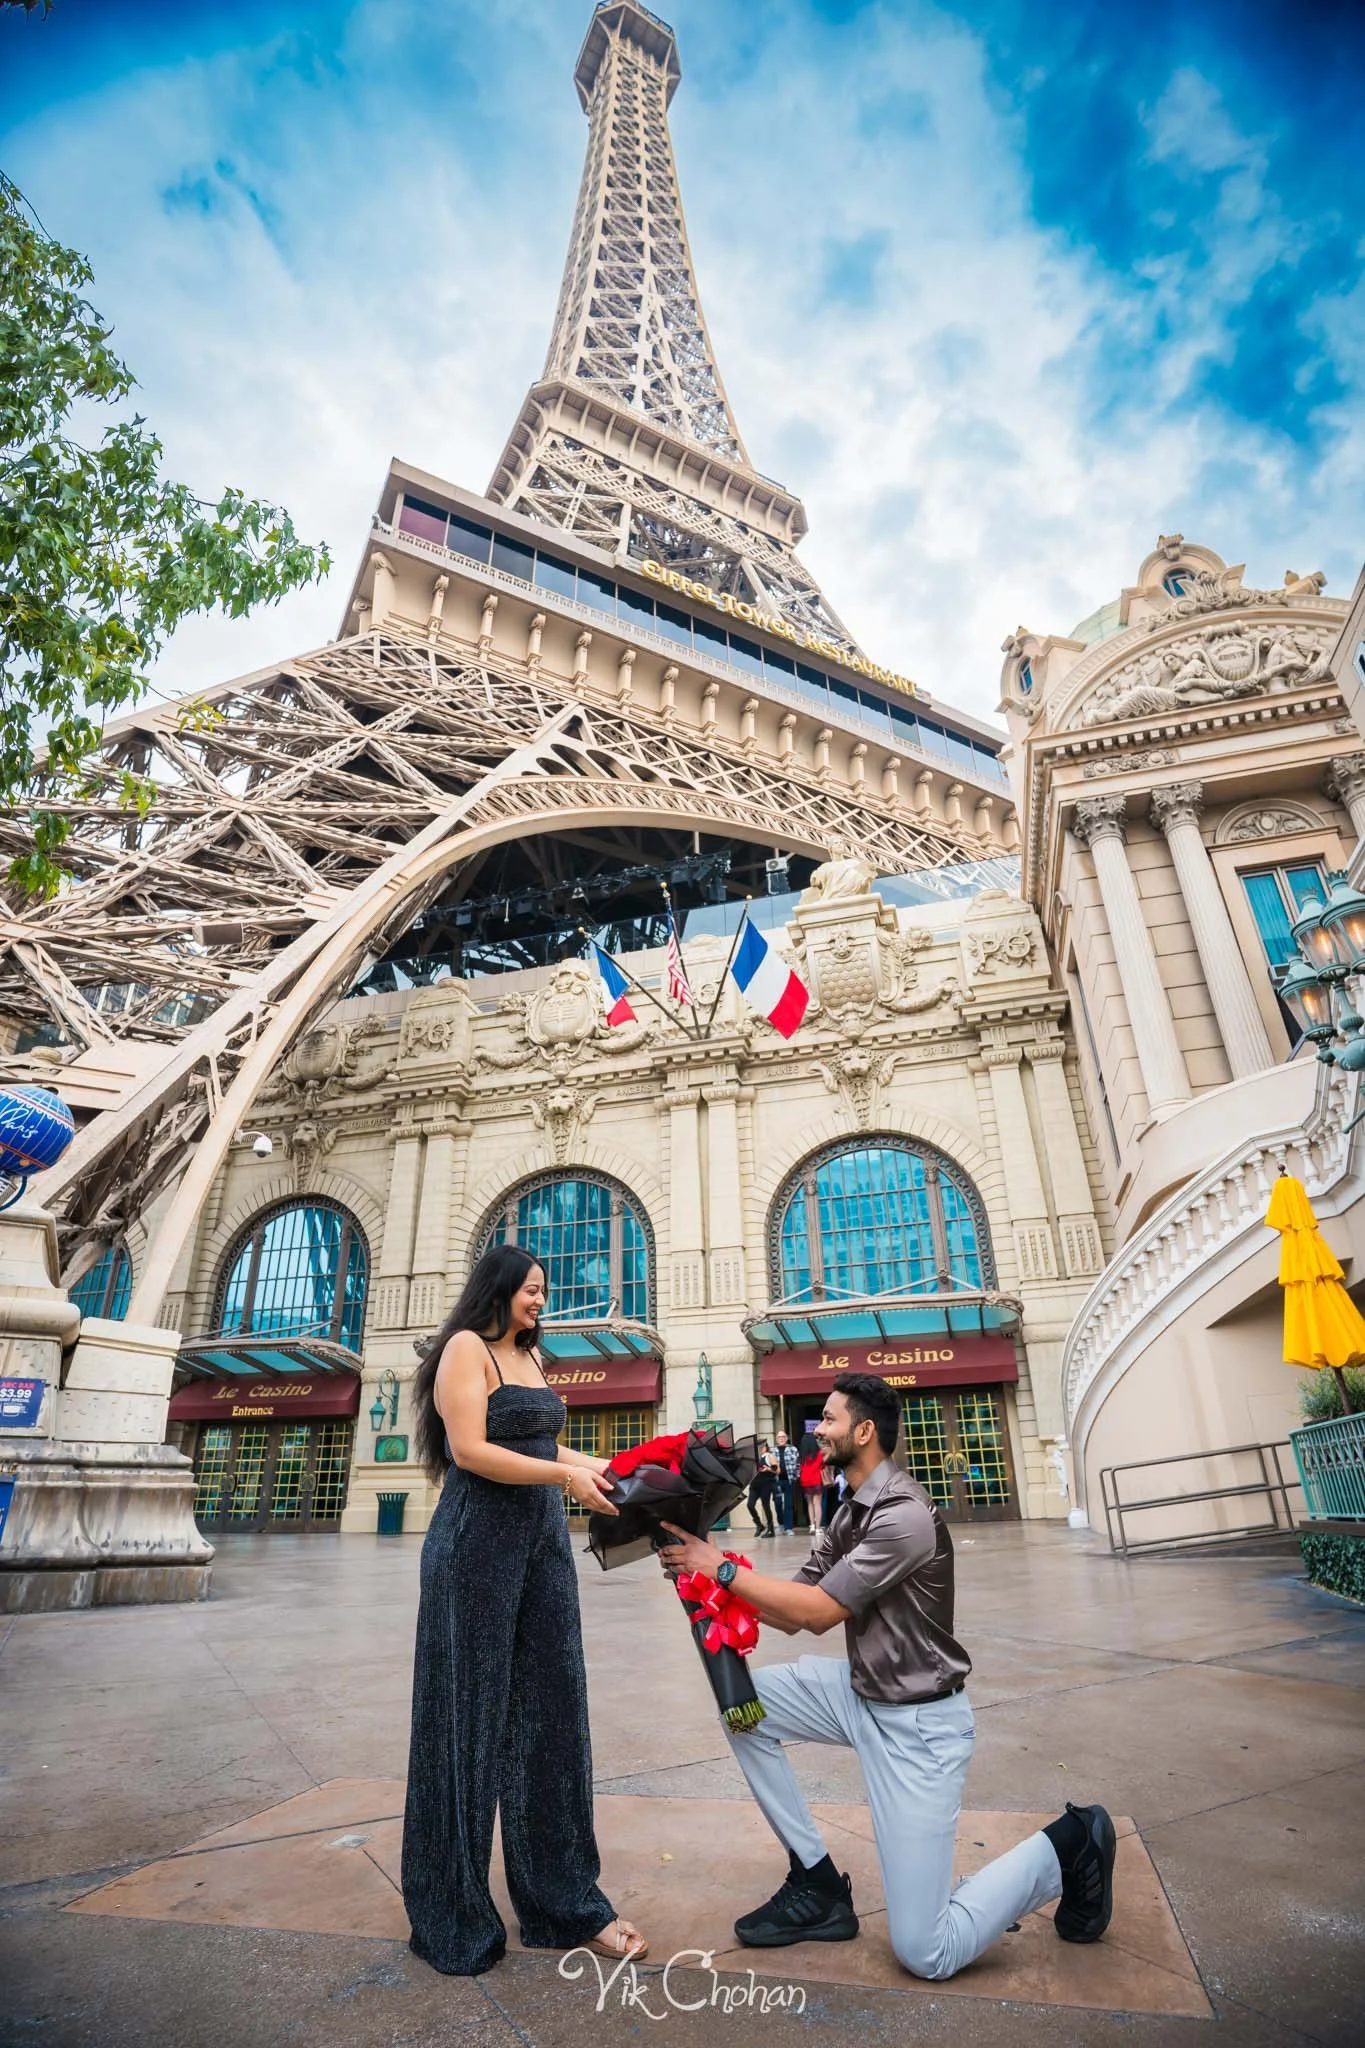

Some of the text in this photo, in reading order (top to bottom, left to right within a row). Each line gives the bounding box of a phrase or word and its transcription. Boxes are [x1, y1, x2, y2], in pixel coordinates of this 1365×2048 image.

[640, 559, 918, 697] EIFFEL TOWER RESTAURANT
[817, 1347, 954, 1370] Le Casino
[544, 1369, 606, 1385] asino
[0, 1388, 32, 1399] $3.99
[211, 1383, 313, 1400] Le Casino
[231, 1405, 274, 1417] Entrance
